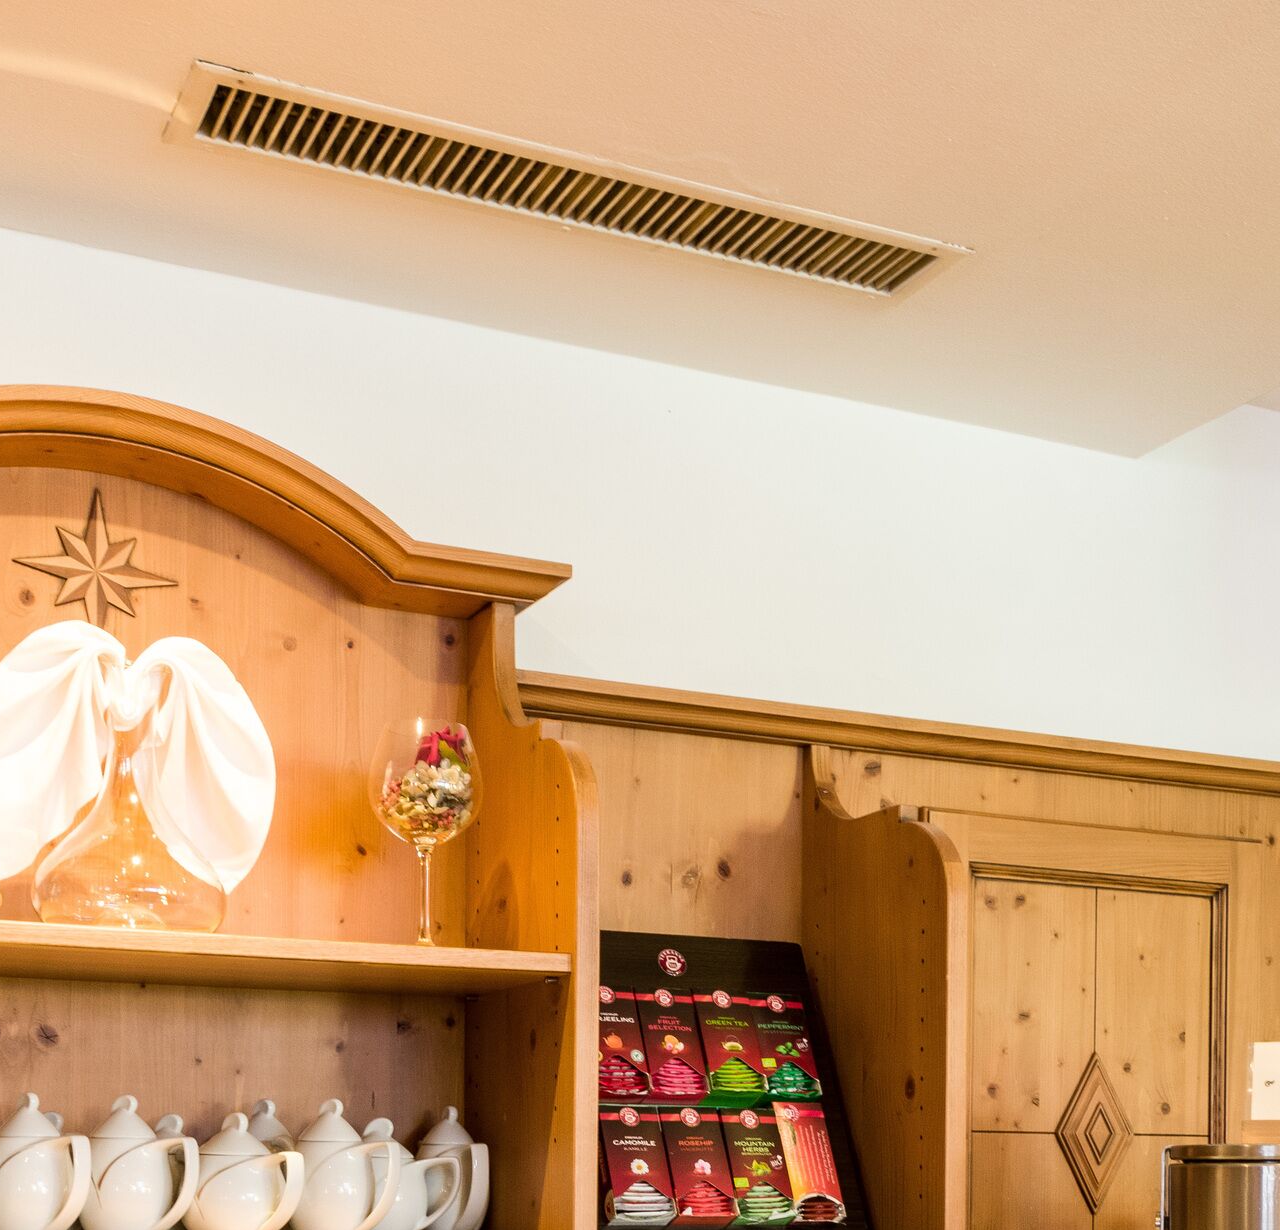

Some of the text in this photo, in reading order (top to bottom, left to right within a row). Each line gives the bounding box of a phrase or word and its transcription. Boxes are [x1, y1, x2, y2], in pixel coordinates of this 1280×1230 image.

[648, 1024, 692, 1032] SELECTION
[757, 1023, 803, 1031] PEPPERMINT
[612, 1139, 657, 1147] CAMOMILE
